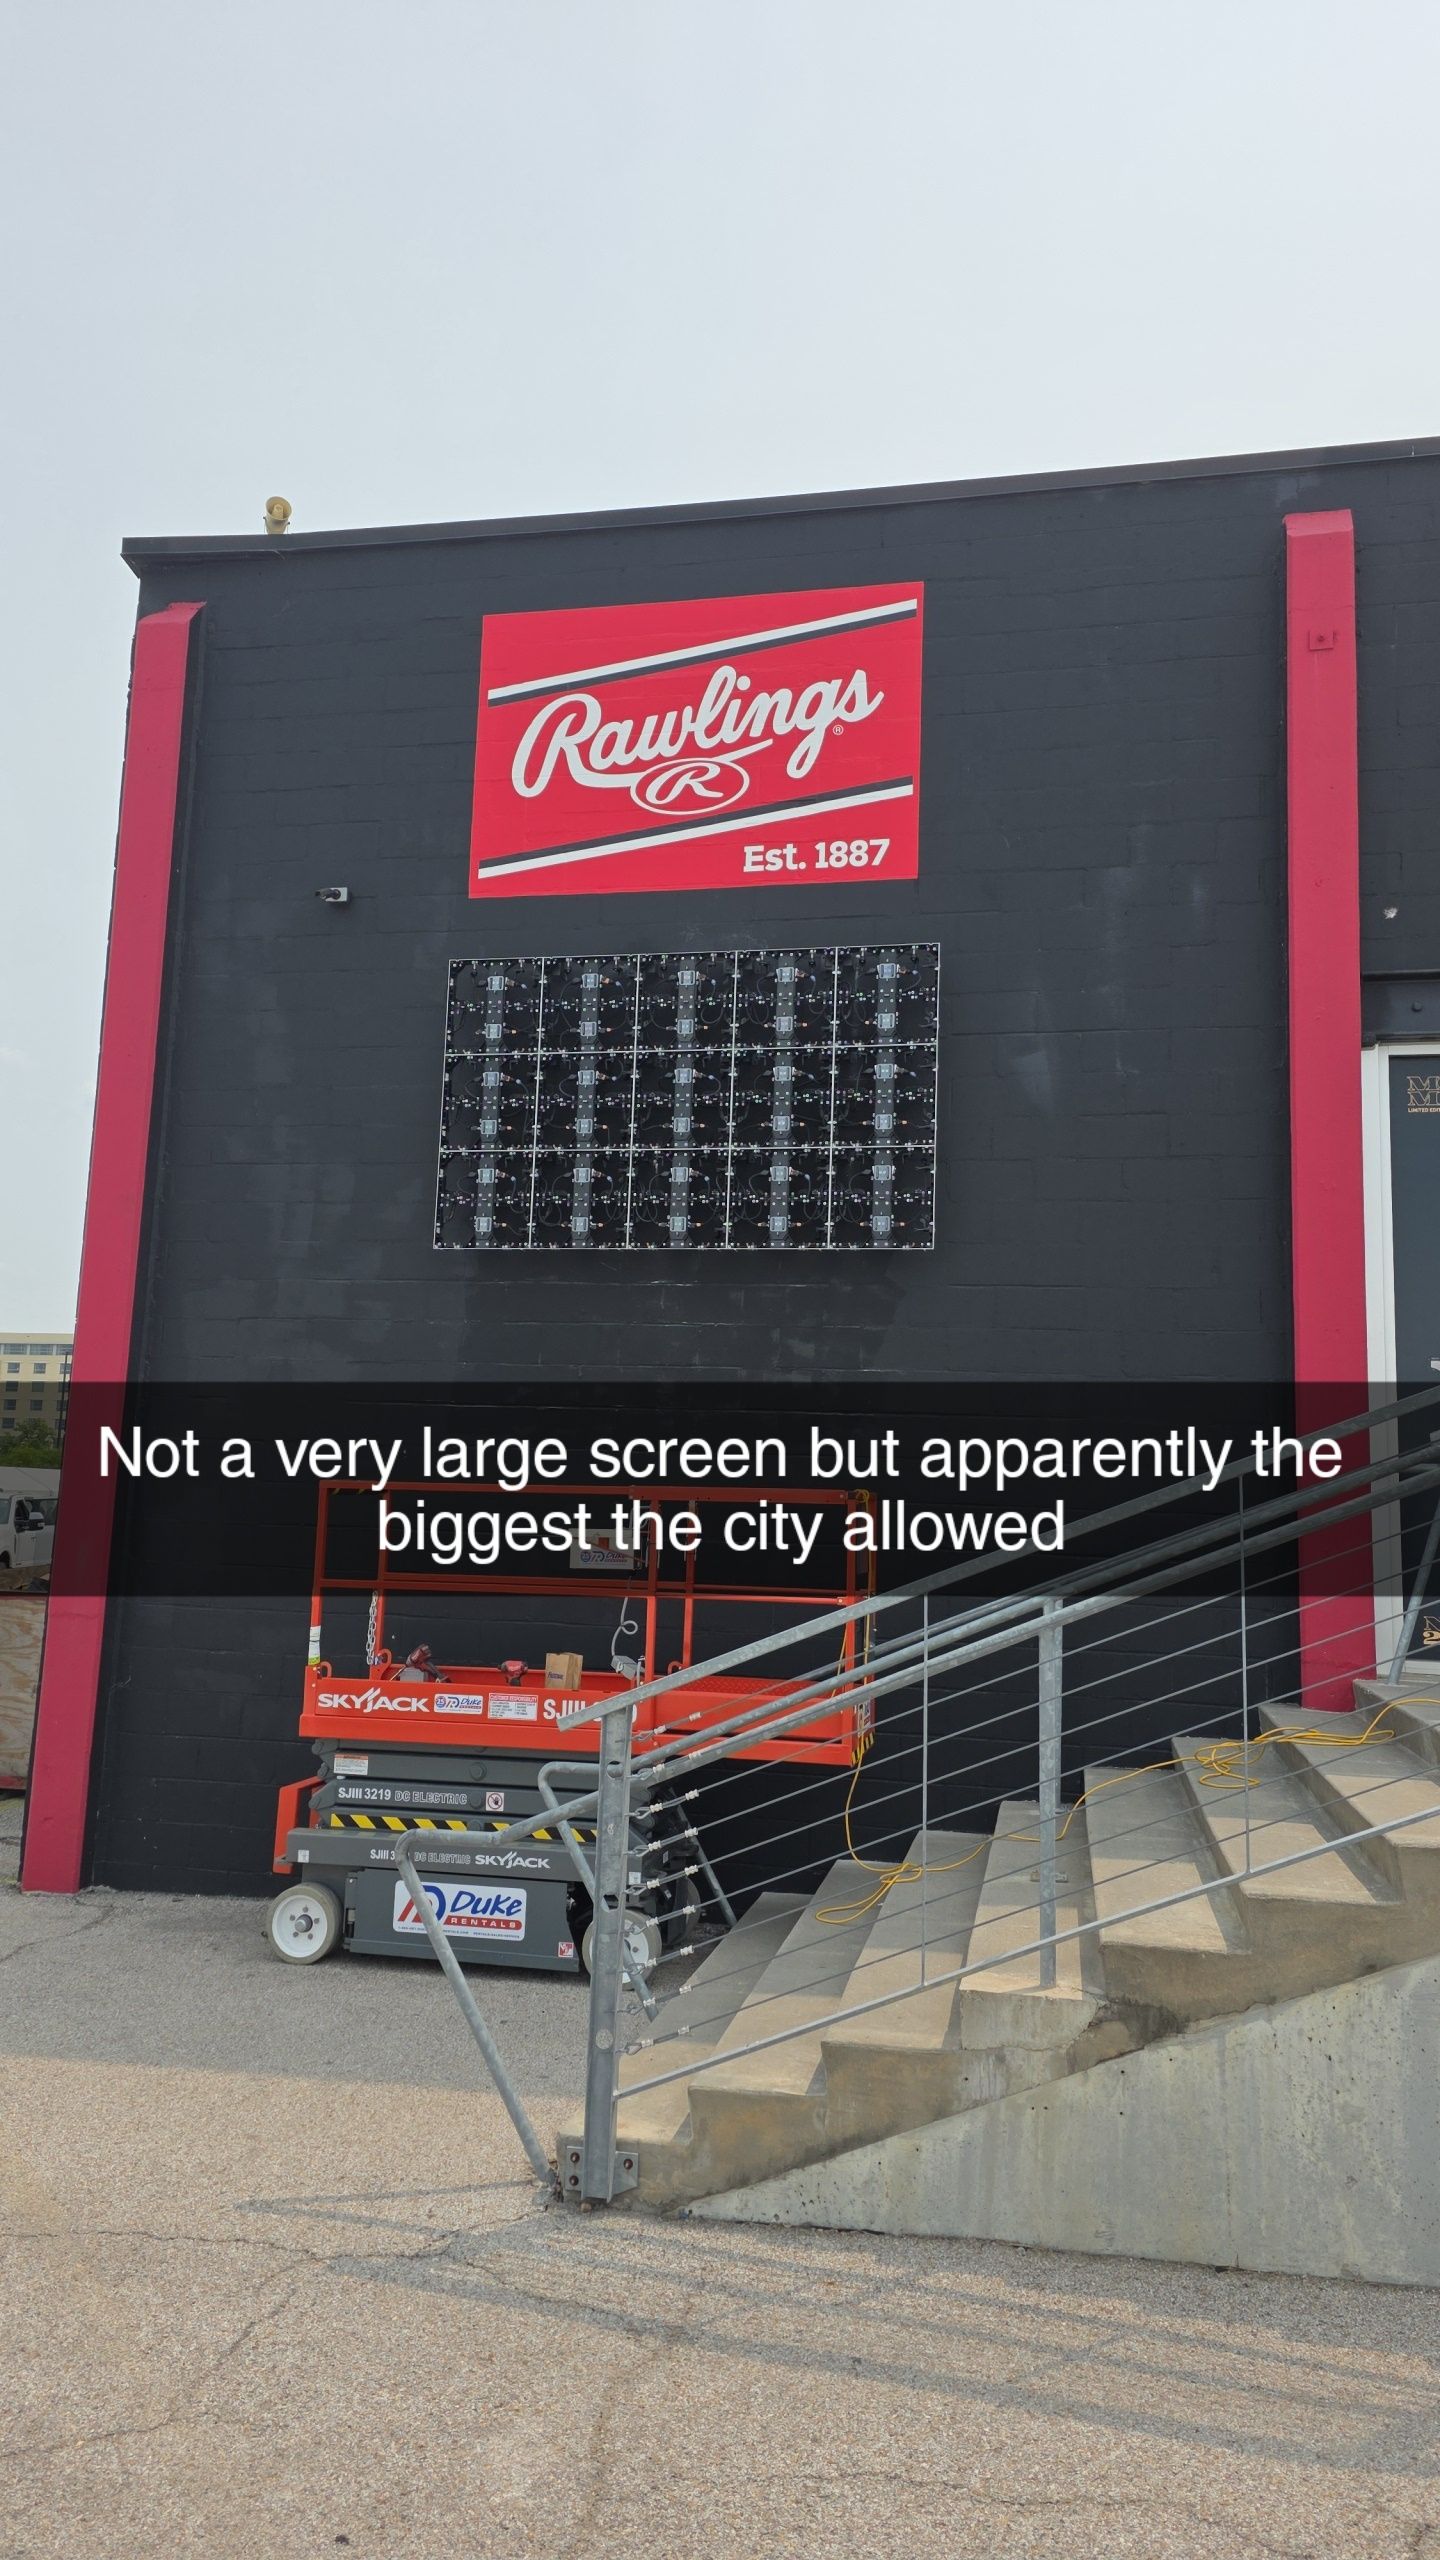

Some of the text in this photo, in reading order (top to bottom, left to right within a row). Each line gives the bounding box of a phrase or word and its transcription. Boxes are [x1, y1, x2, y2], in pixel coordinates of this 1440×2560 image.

[511, 665, 885, 798] Rawlings
[743, 838, 890, 873] Est. 1887
[318, 1687, 430, 1713] SKYJACK
[338, 1787, 468, 1804] SJIII 3219 DC ELECTRIC
[370, 1849, 389, 1860] SJIII
[414, 1851, 427, 1862] DC
[428, 1852, 471, 1864] ELECTRIC
[475, 1851, 551, 1868] SKYJACK
[450, 1890, 523, 1917] Duke
[450, 1917, 517, 1928] RENTALS
